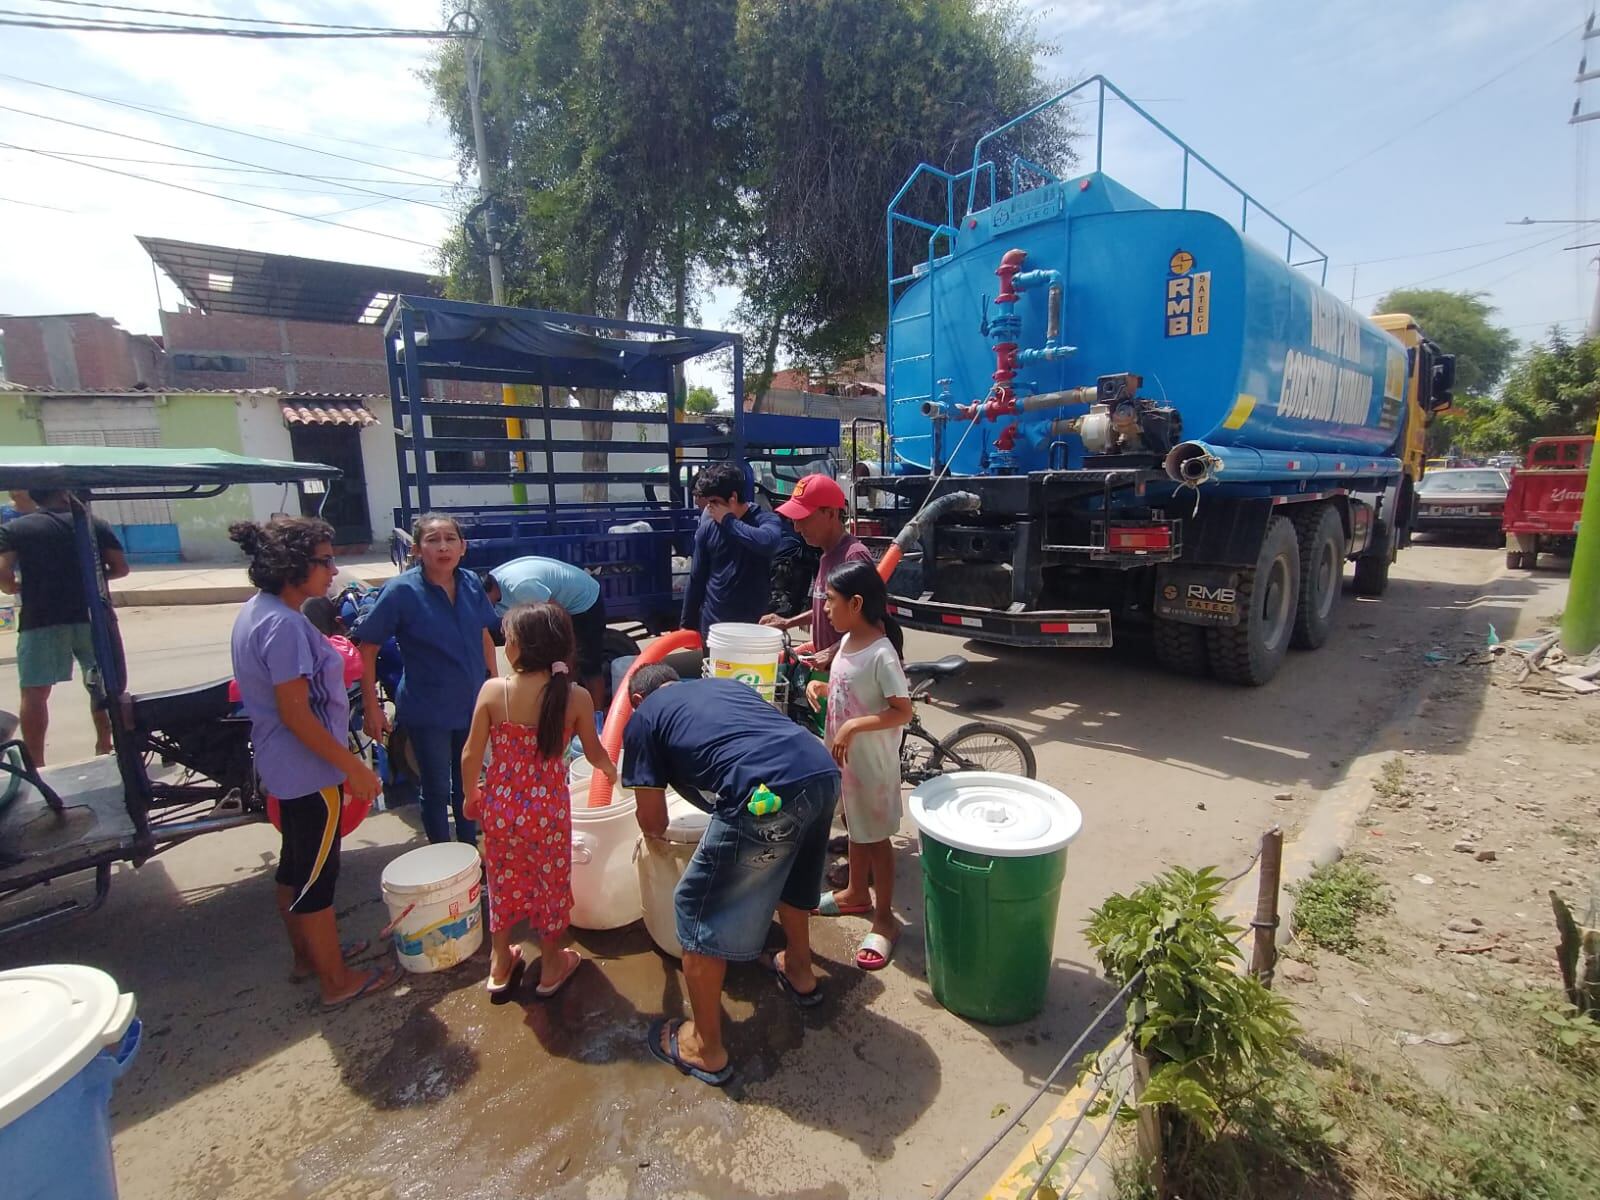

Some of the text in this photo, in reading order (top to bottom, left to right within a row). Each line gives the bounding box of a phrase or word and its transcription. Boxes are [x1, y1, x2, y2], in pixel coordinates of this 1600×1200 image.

[1167, 277, 1191, 336] RMB
[1197, 274, 1206, 333] SATECI
[1186, 600, 1235, 612] SATECI
[1187, 584, 1236, 603] RMB
